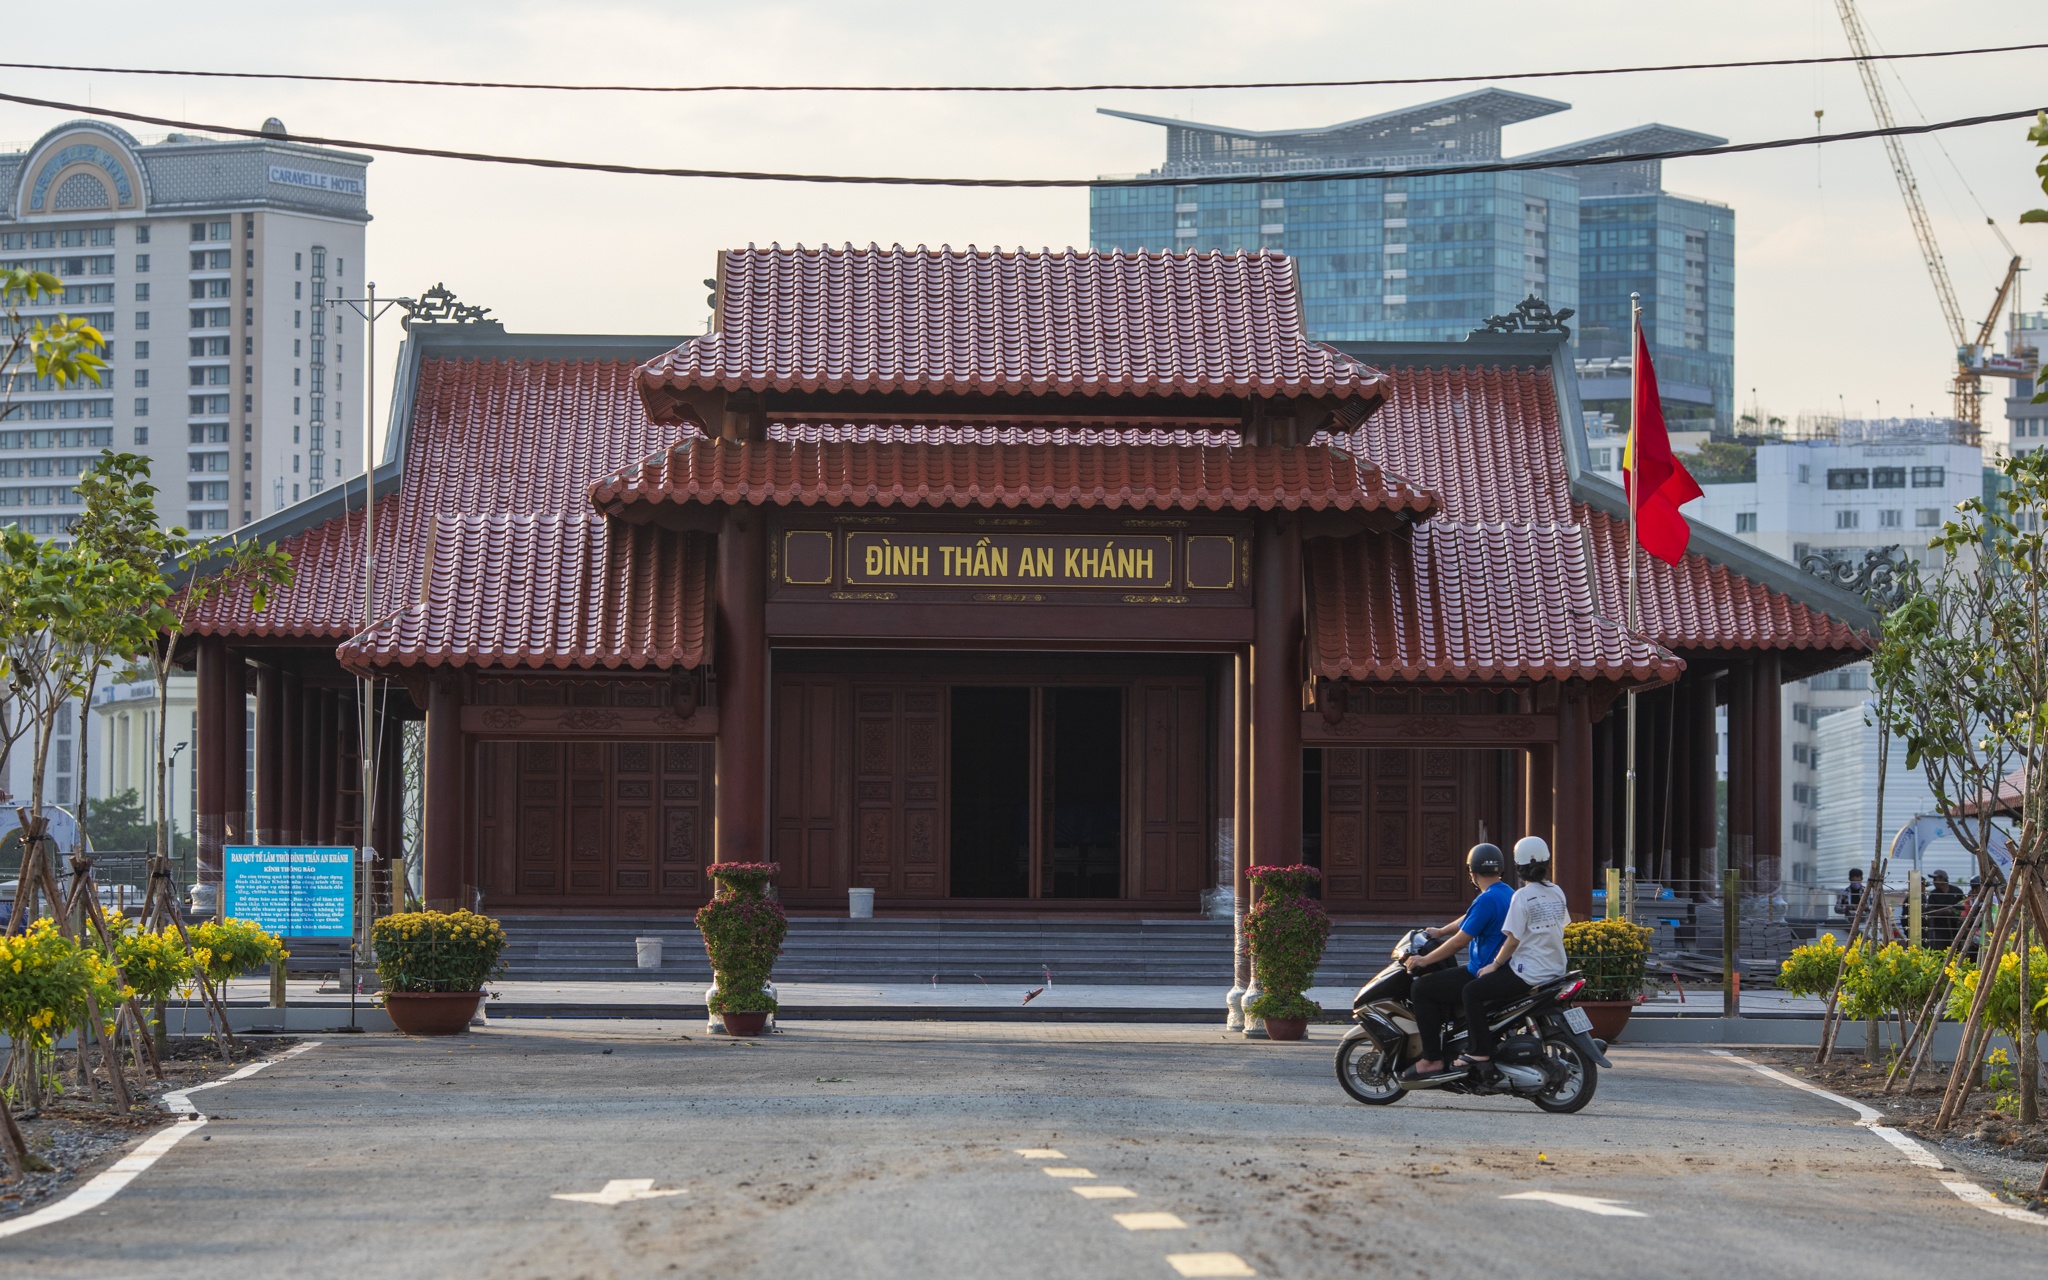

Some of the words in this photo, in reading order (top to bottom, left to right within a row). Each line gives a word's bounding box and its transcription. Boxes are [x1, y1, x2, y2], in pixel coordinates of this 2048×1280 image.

[31, 145, 97, 209] CARAVELLE
[101, 155, 132, 205] HOTEL
[271, 168, 327, 189] CARAVELLE
[330, 176, 362, 194] HOTEL
[865, 538, 929, 576] ĐÌNH
[938, 536, 1008, 577] THẦN
[1018, 547, 1053, 578] AN
[1064, 541, 1154, 579] KHÁNH
[231, 854, 242, 862] BAN
[321, 854, 328, 862] AN
[329, 852, 348, 862] KHÁNH
